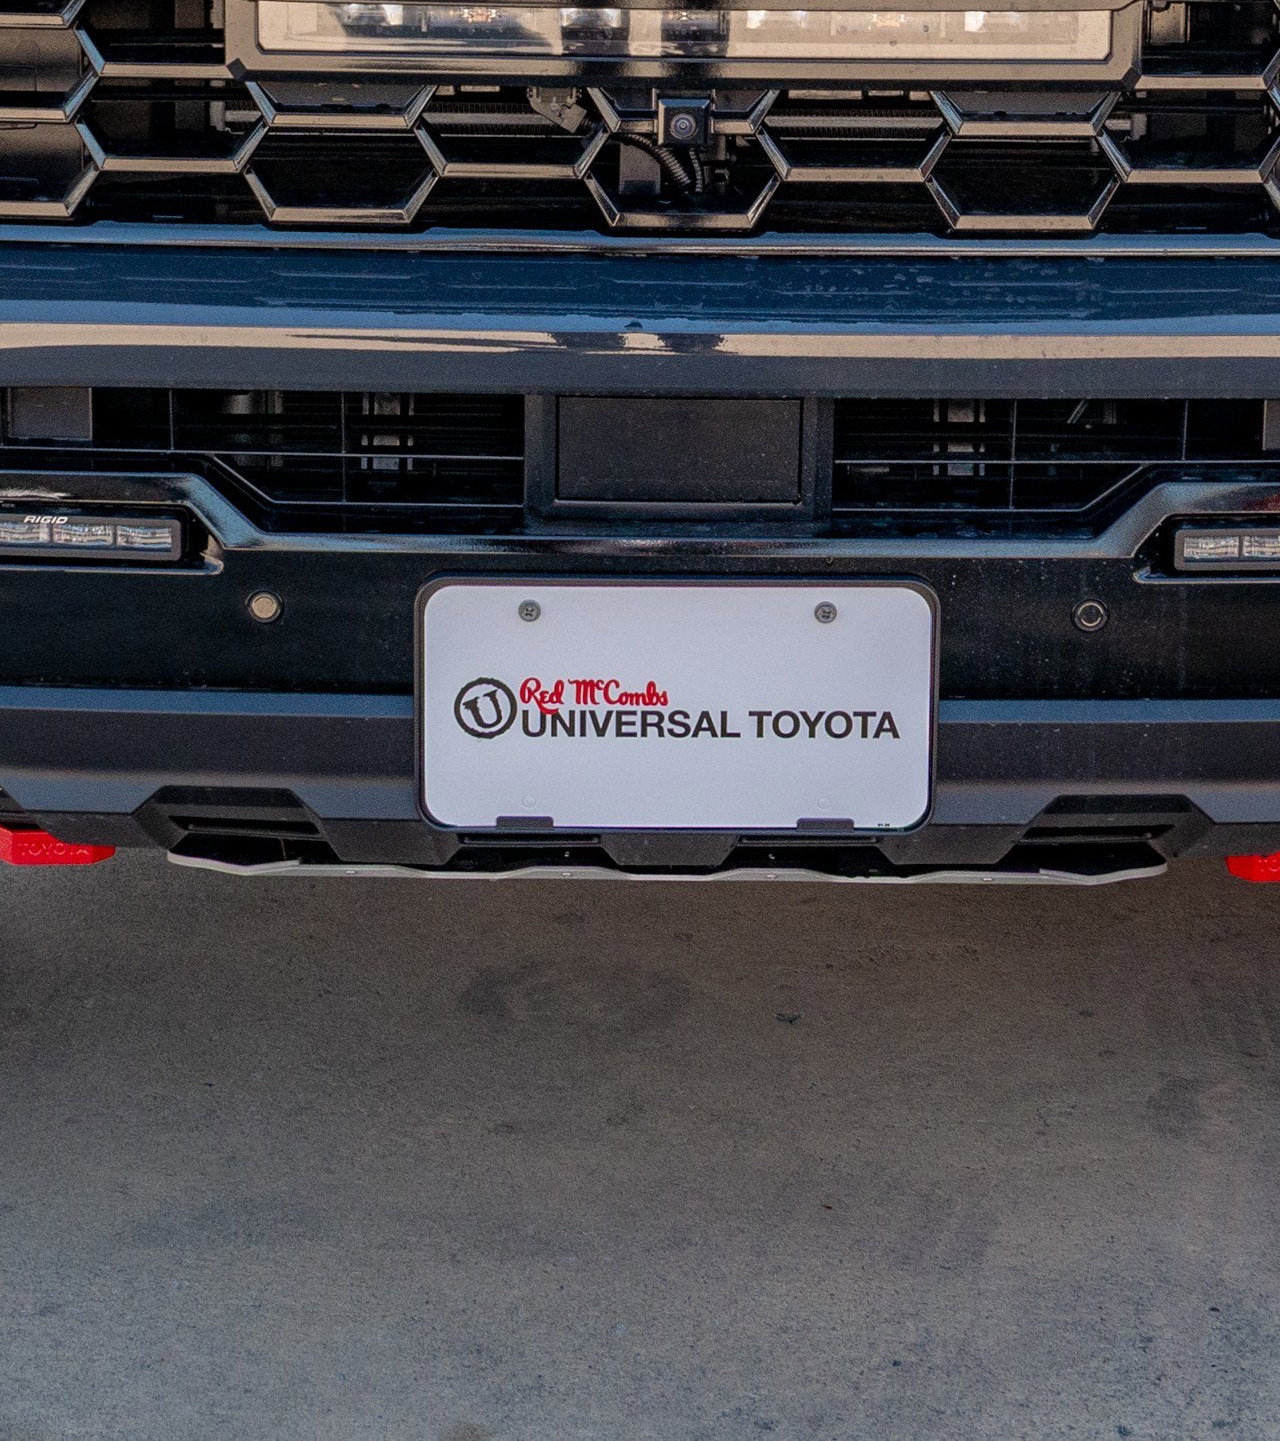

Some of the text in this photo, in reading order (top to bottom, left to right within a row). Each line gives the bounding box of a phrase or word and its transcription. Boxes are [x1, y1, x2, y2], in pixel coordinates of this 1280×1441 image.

[23, 515, 69, 524] RIGID
[520, 677, 669, 715] Red McCombs
[522, 709, 901, 739] UNIVERSAL TOYOTA
